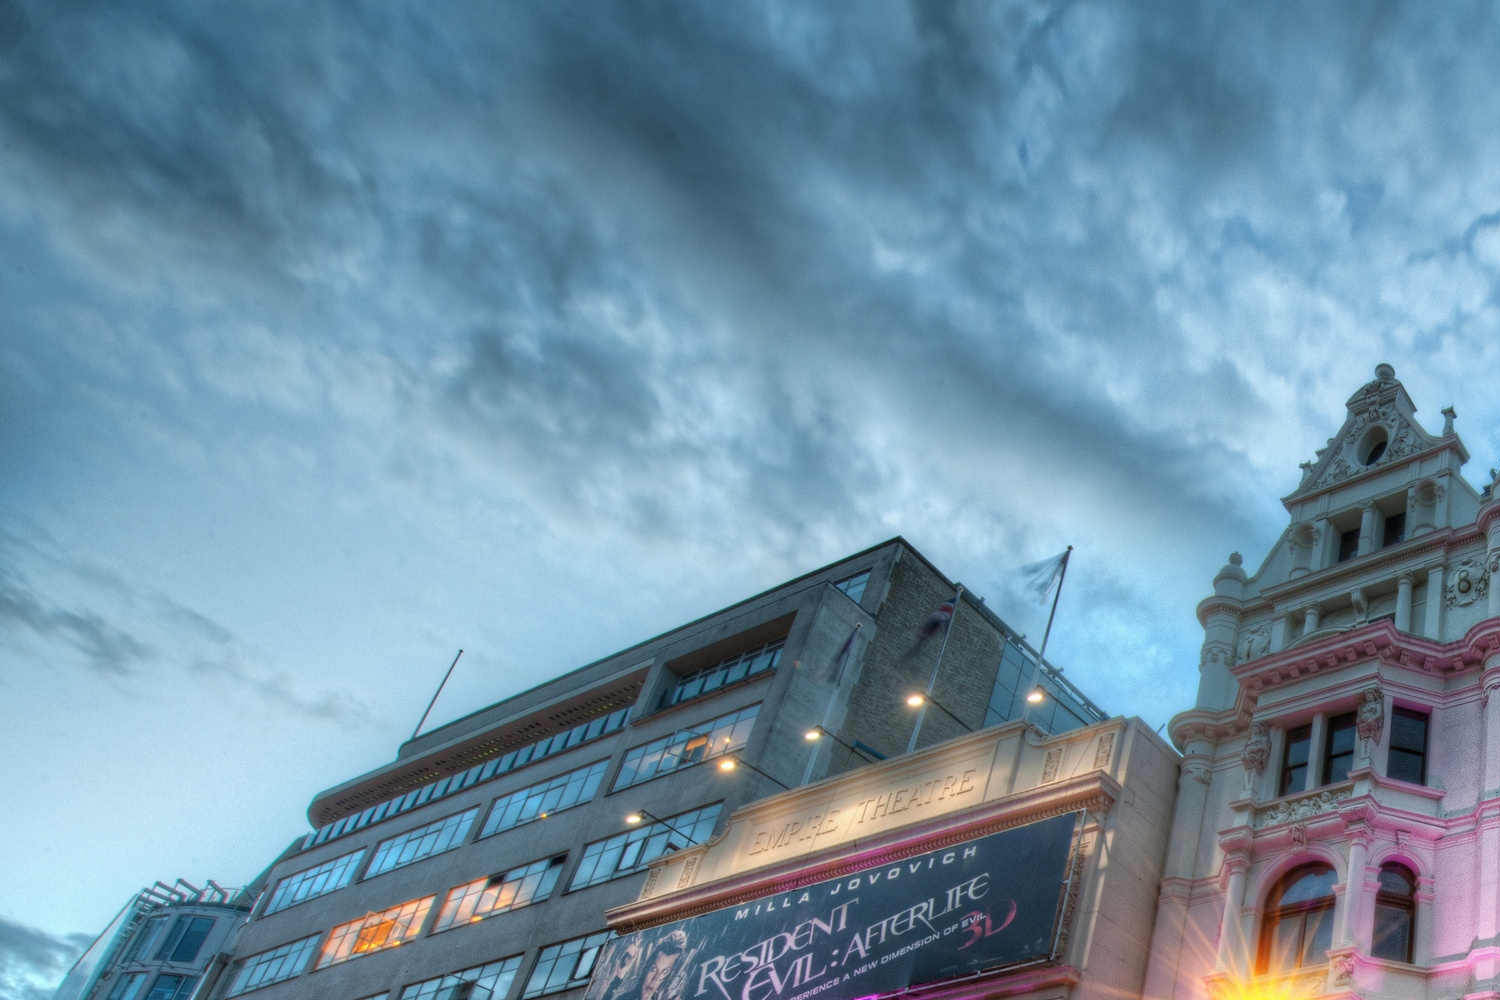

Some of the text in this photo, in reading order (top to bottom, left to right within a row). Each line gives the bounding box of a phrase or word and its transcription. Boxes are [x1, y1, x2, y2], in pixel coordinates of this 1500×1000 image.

[749, 768, 976, 856] EMPIRE THEATRE
[735, 846, 978, 921] MILLA JOVOVICH
[842, 872, 991, 966] AFTERLIFE
[842, 973, 852, 982] A
[853, 960, 878, 978] NEW
[881, 932, 940, 964] DIMENSION
[943, 924, 959, 936] OF
[962, 912, 987, 928] EVIL
[957, 898, 1018, 951] 3D
